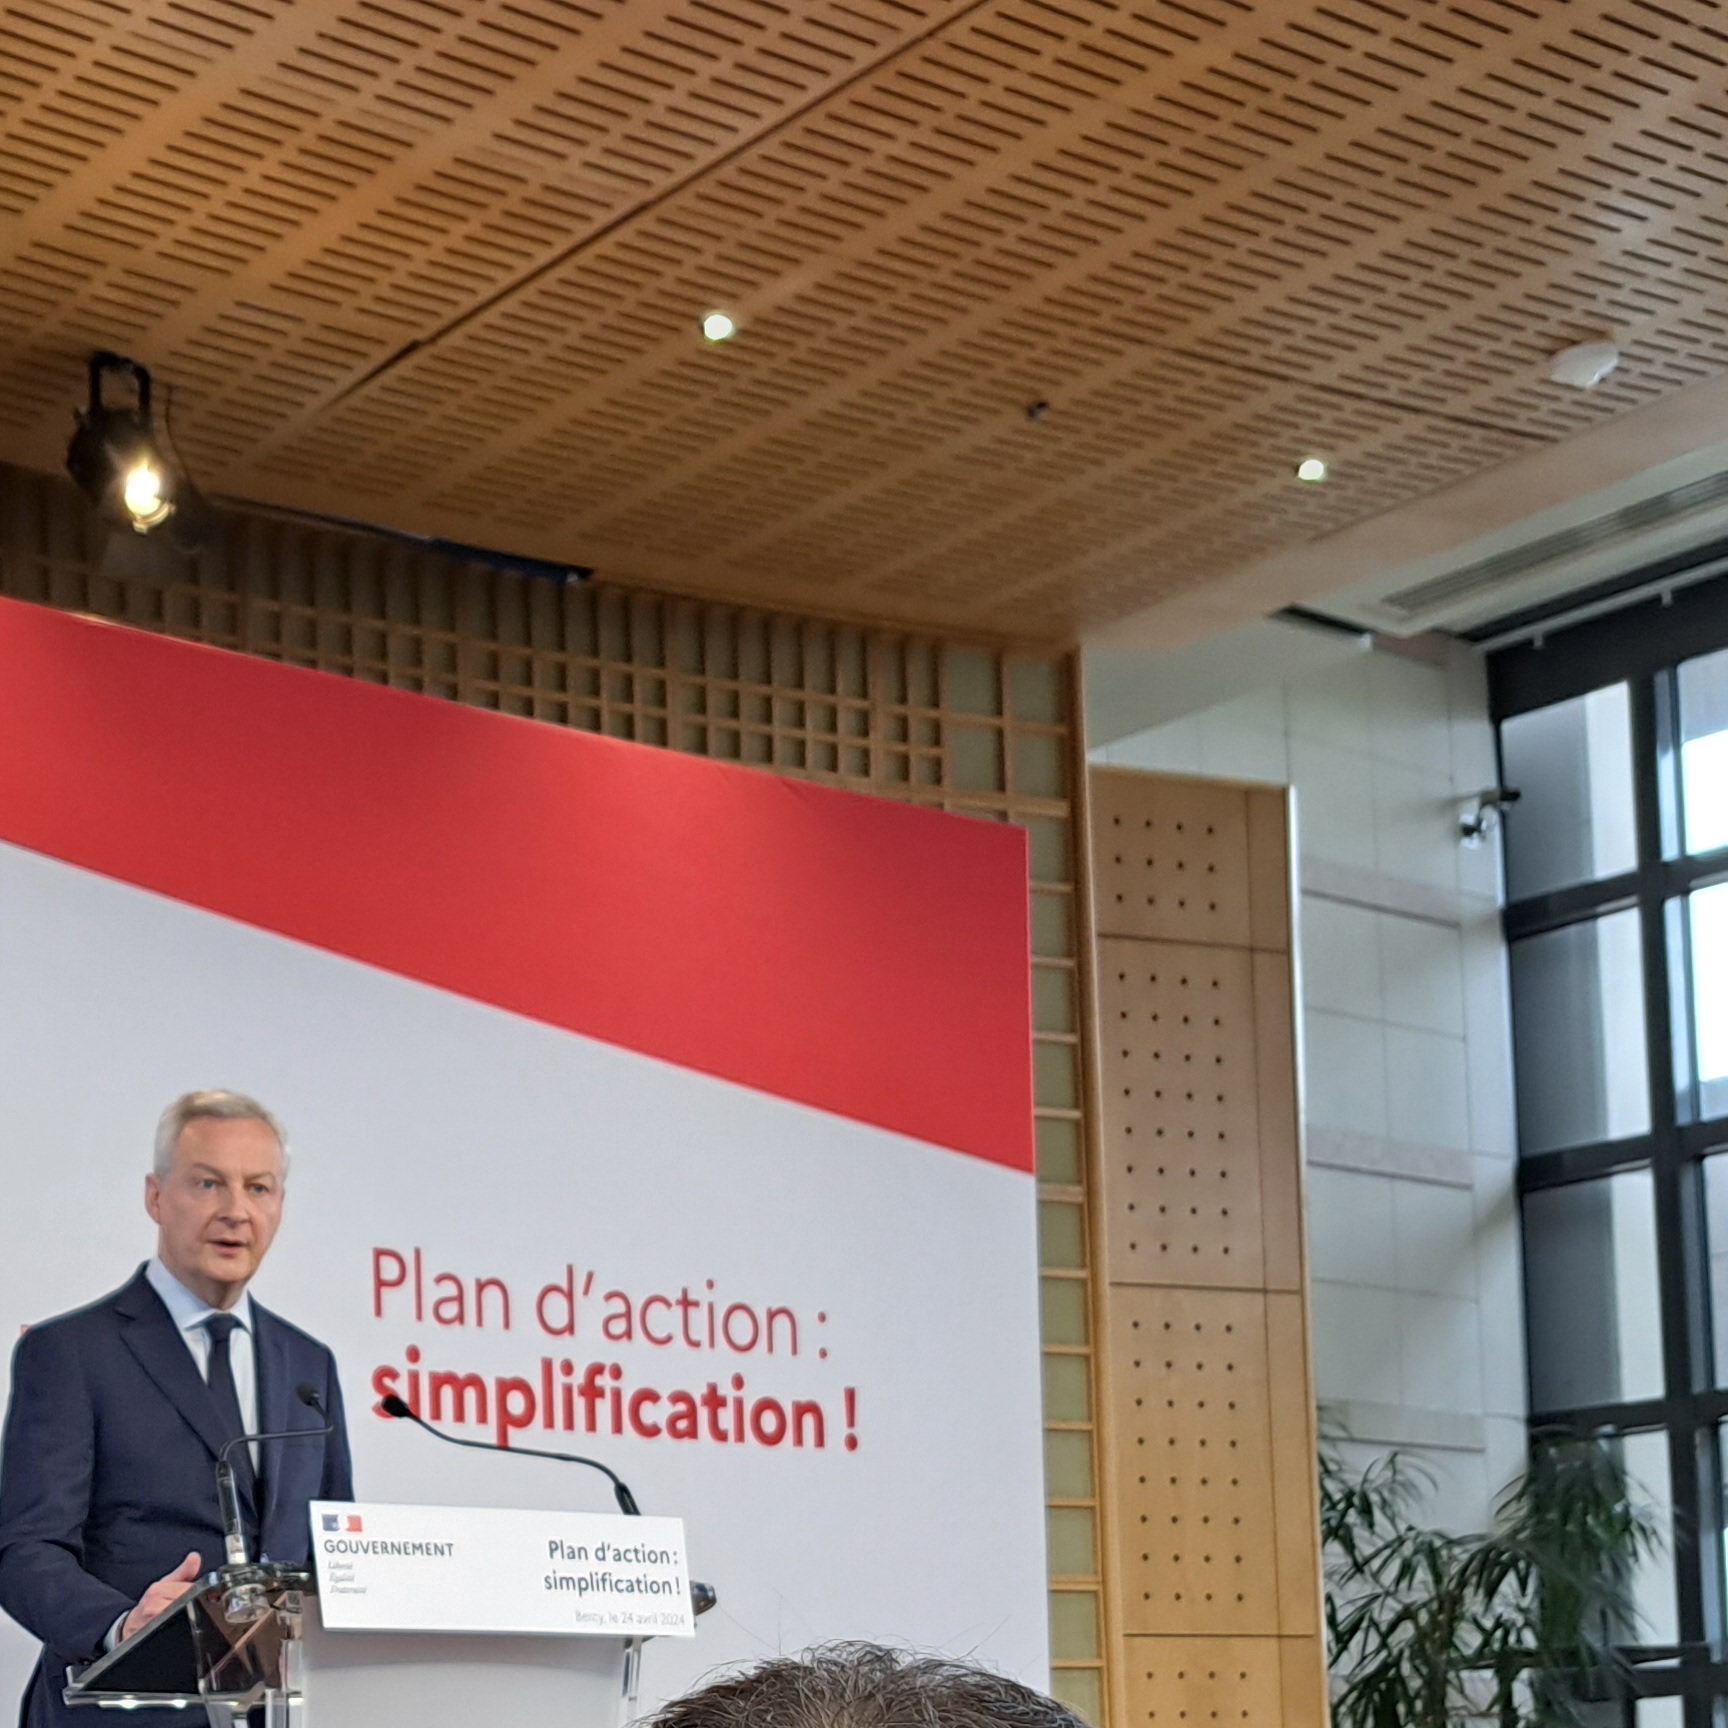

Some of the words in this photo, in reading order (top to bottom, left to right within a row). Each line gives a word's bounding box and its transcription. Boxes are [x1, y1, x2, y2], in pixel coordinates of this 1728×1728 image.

[372, 1247, 511, 1331] Plan
[323, 1538, 455, 1557] GOUVERNEMENT
[547, 1539, 589, 1562] Plan
[621, 1612, 634, 1625] 24
[660, 1613, 685, 1626] 2024
